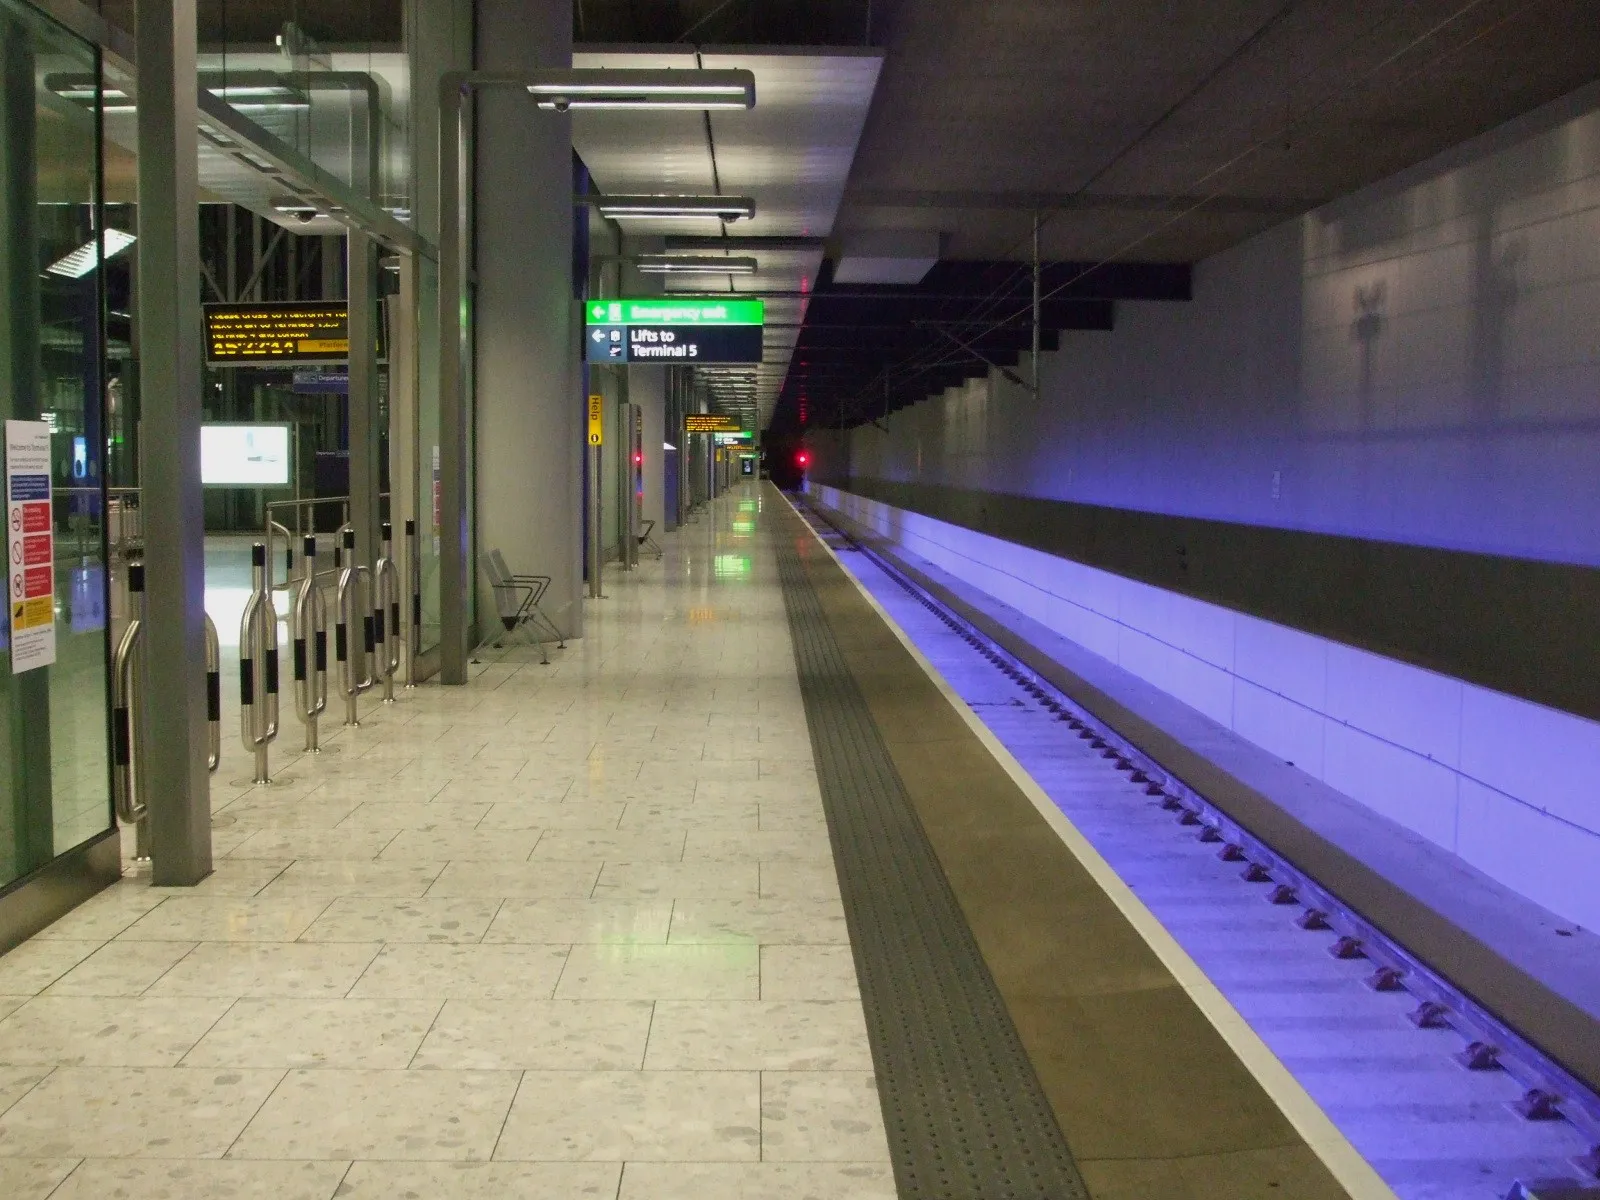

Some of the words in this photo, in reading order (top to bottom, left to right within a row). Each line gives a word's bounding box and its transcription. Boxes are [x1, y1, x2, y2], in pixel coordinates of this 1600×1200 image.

[631, 305, 699, 320] Emergency
[702, 305, 727, 319] exit
[631, 330, 658, 342] Lifts
[660, 330, 675, 342] to
[631, 344, 686, 357] Terminal
[689, 344, 698, 357] 5
[591, 397, 600, 420] Help
